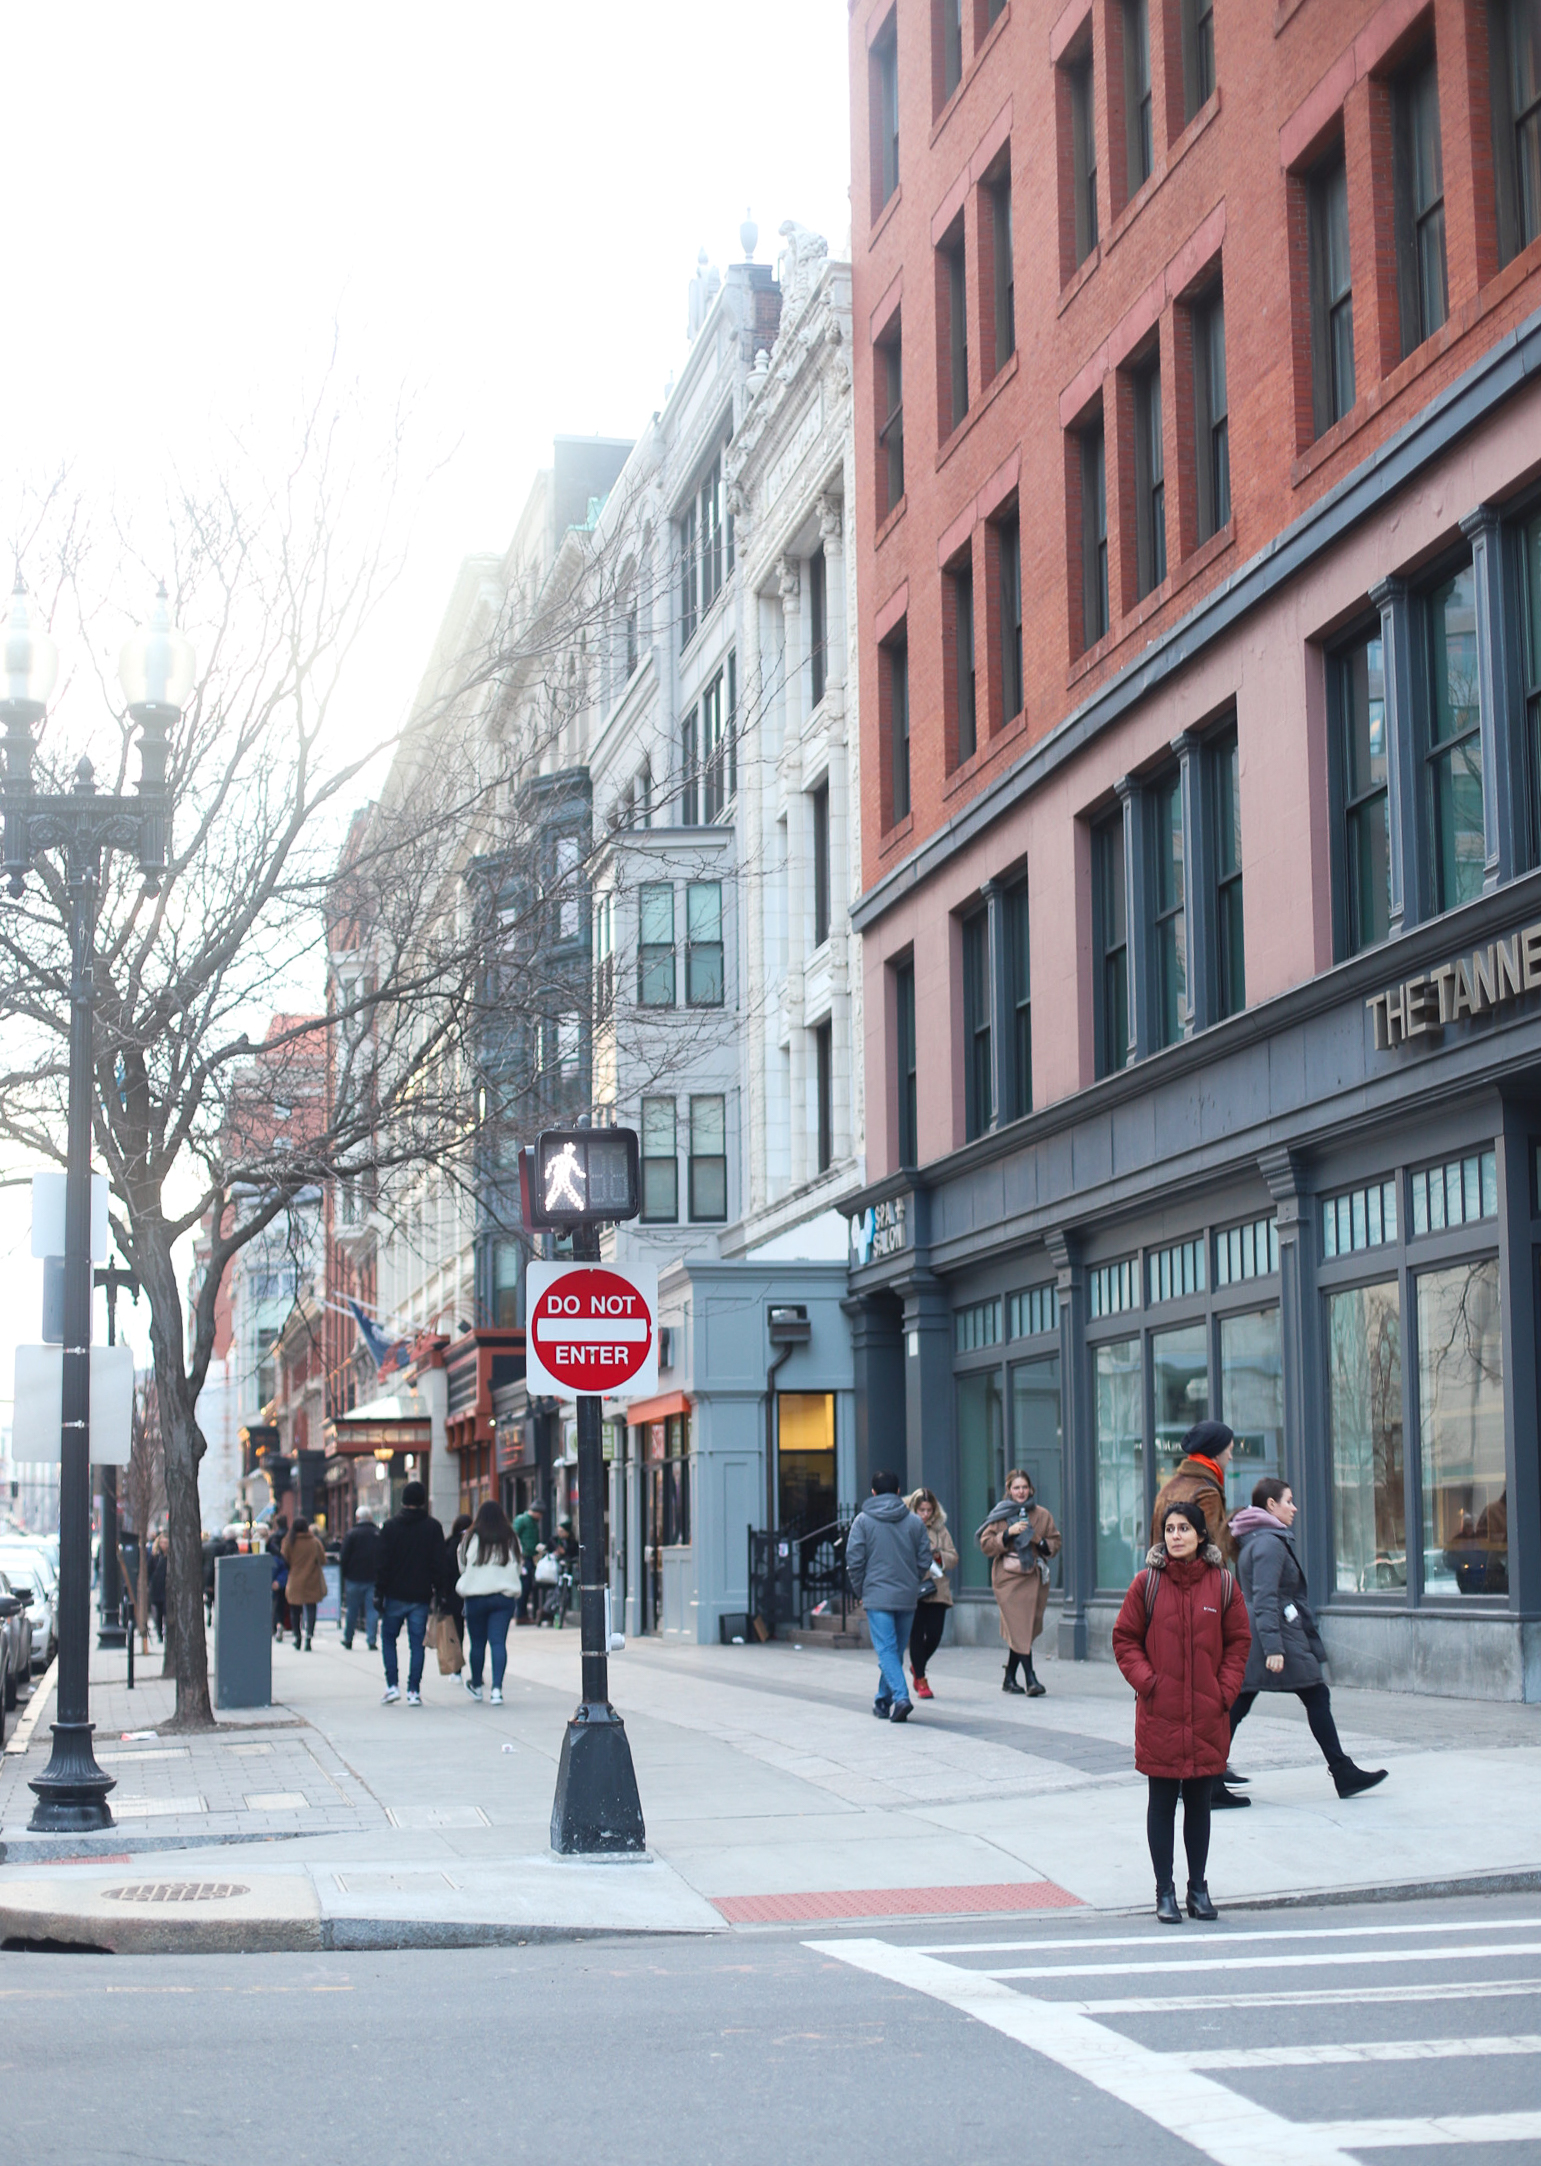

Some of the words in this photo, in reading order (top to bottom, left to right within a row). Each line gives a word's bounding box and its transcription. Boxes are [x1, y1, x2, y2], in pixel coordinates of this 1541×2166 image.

[1366, 974, 1428, 1051] THE
[1430, 922, 1541, 1025] TANNE
[875, 1201, 894, 1230] SPA
[873, 1223, 905, 1257] SALON
[547, 1295, 581, 1315] DO
[590, 1295, 636, 1315] NOT
[555, 1345, 629, 1365] ENTER
